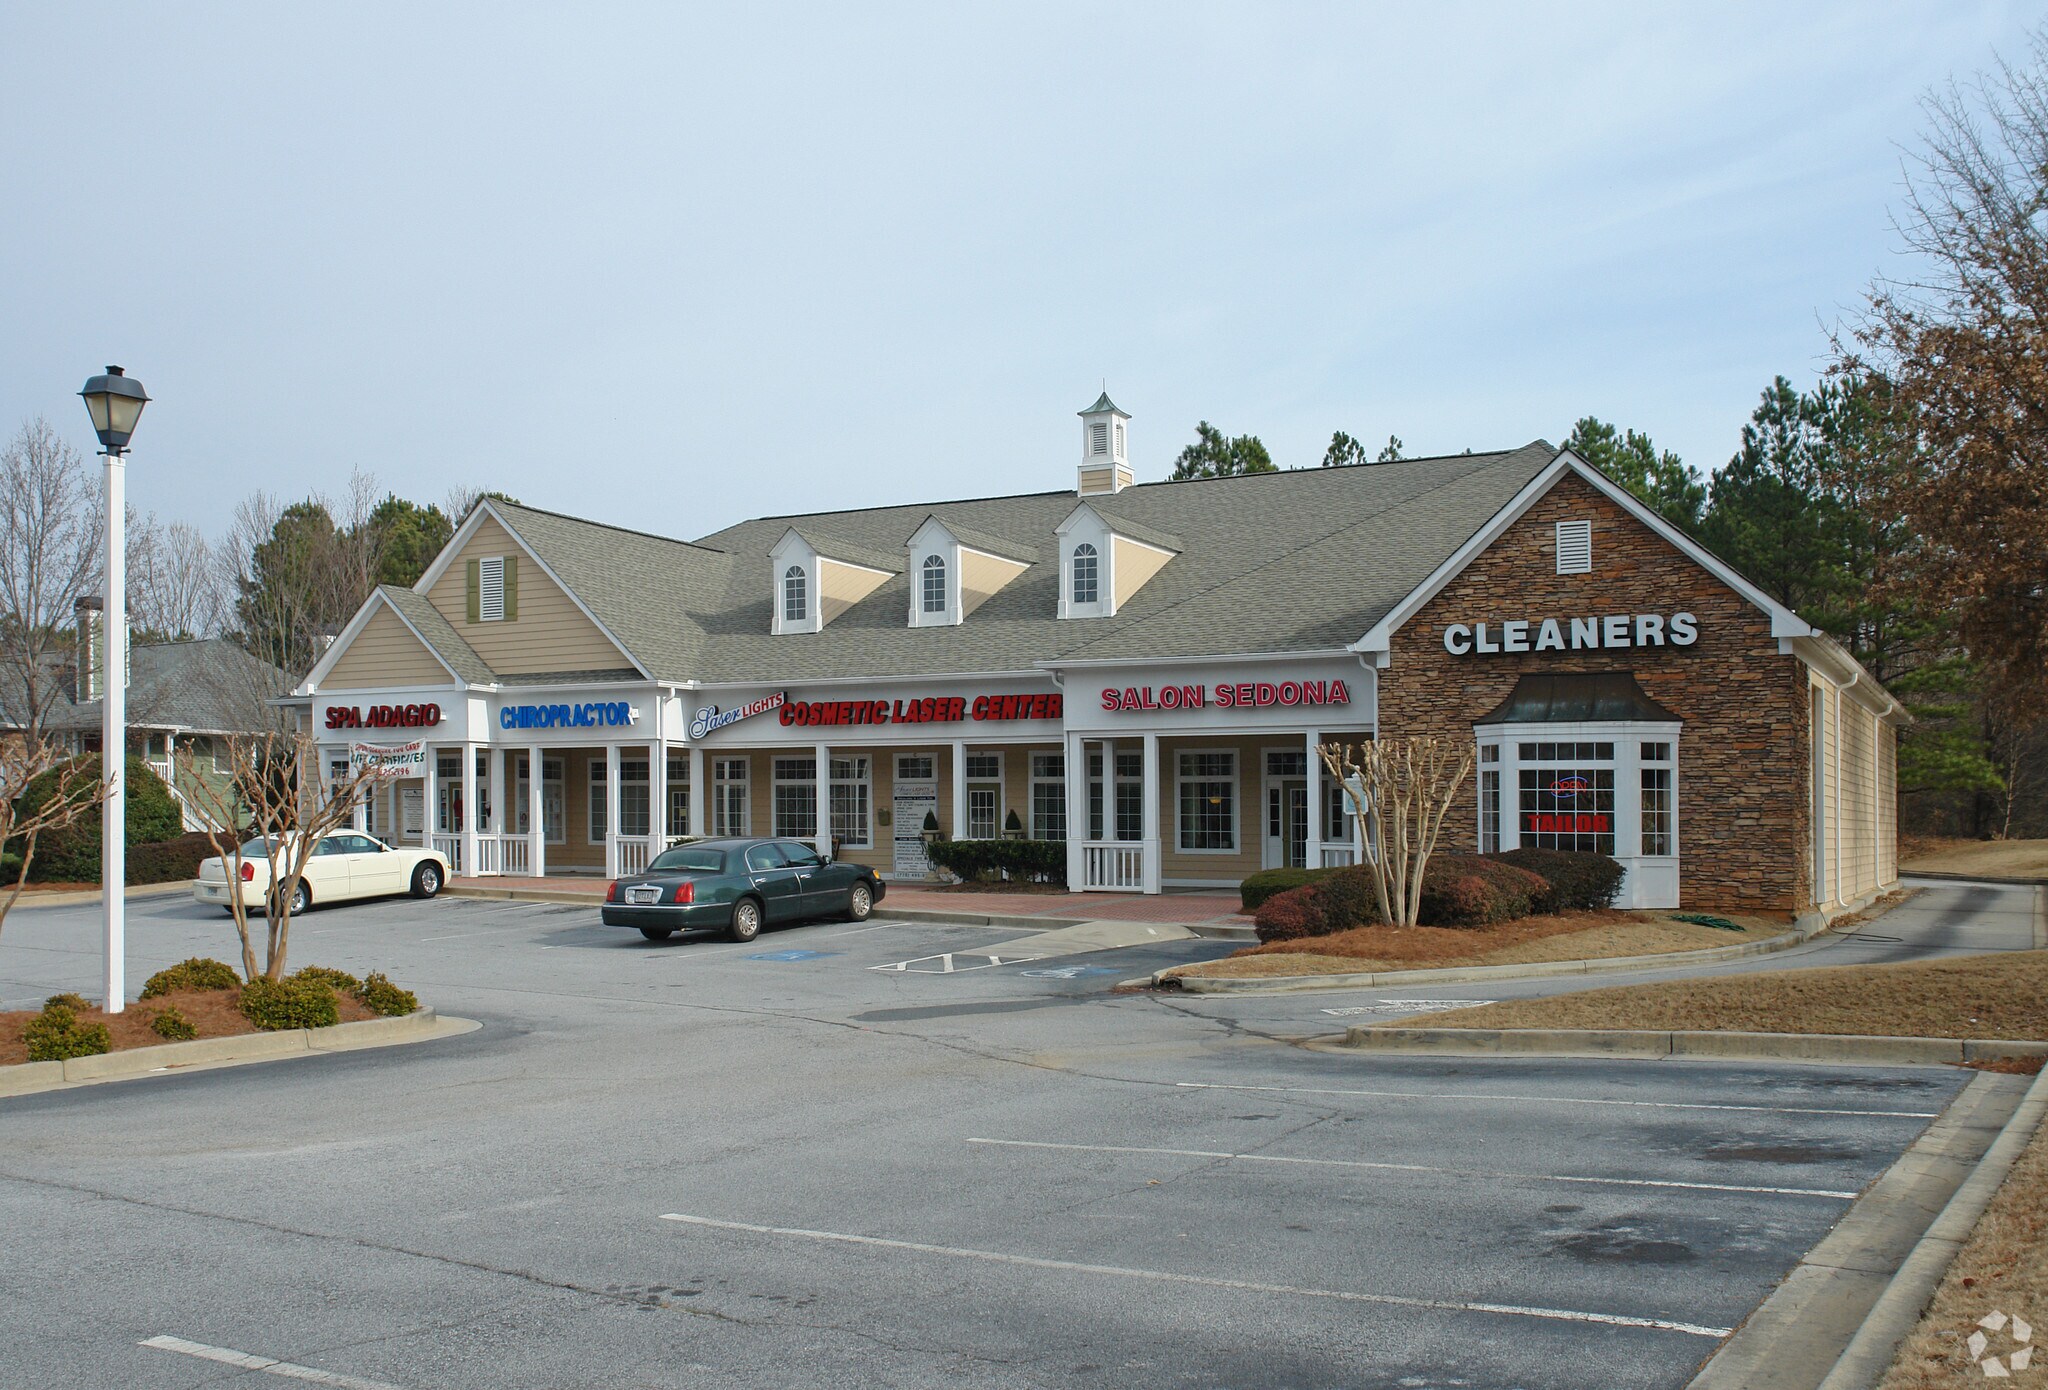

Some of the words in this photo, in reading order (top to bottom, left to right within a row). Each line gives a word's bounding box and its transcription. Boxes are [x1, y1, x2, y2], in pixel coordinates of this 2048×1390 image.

[1443, 612, 1699, 655] CLEANERS
[779, 700, 889, 726] COSMETIC
[891, 697, 966, 723] LASER
[972, 693, 1063, 721] CENTER
[1101, 686, 1205, 711] SALON
[1214, 679, 1351, 708] SEDONA
[325, 706, 362, 729] SPA
[365, 703, 441, 728] ADAGIO
[500, 702, 634, 729] CHIROPRACTOR
[690, 705, 740, 737] Laser
[742, 692, 783, 718] LIGHTS
[1550, 781, 1587, 794] OPEN
[1527, 814, 1609, 833] TAILOR
